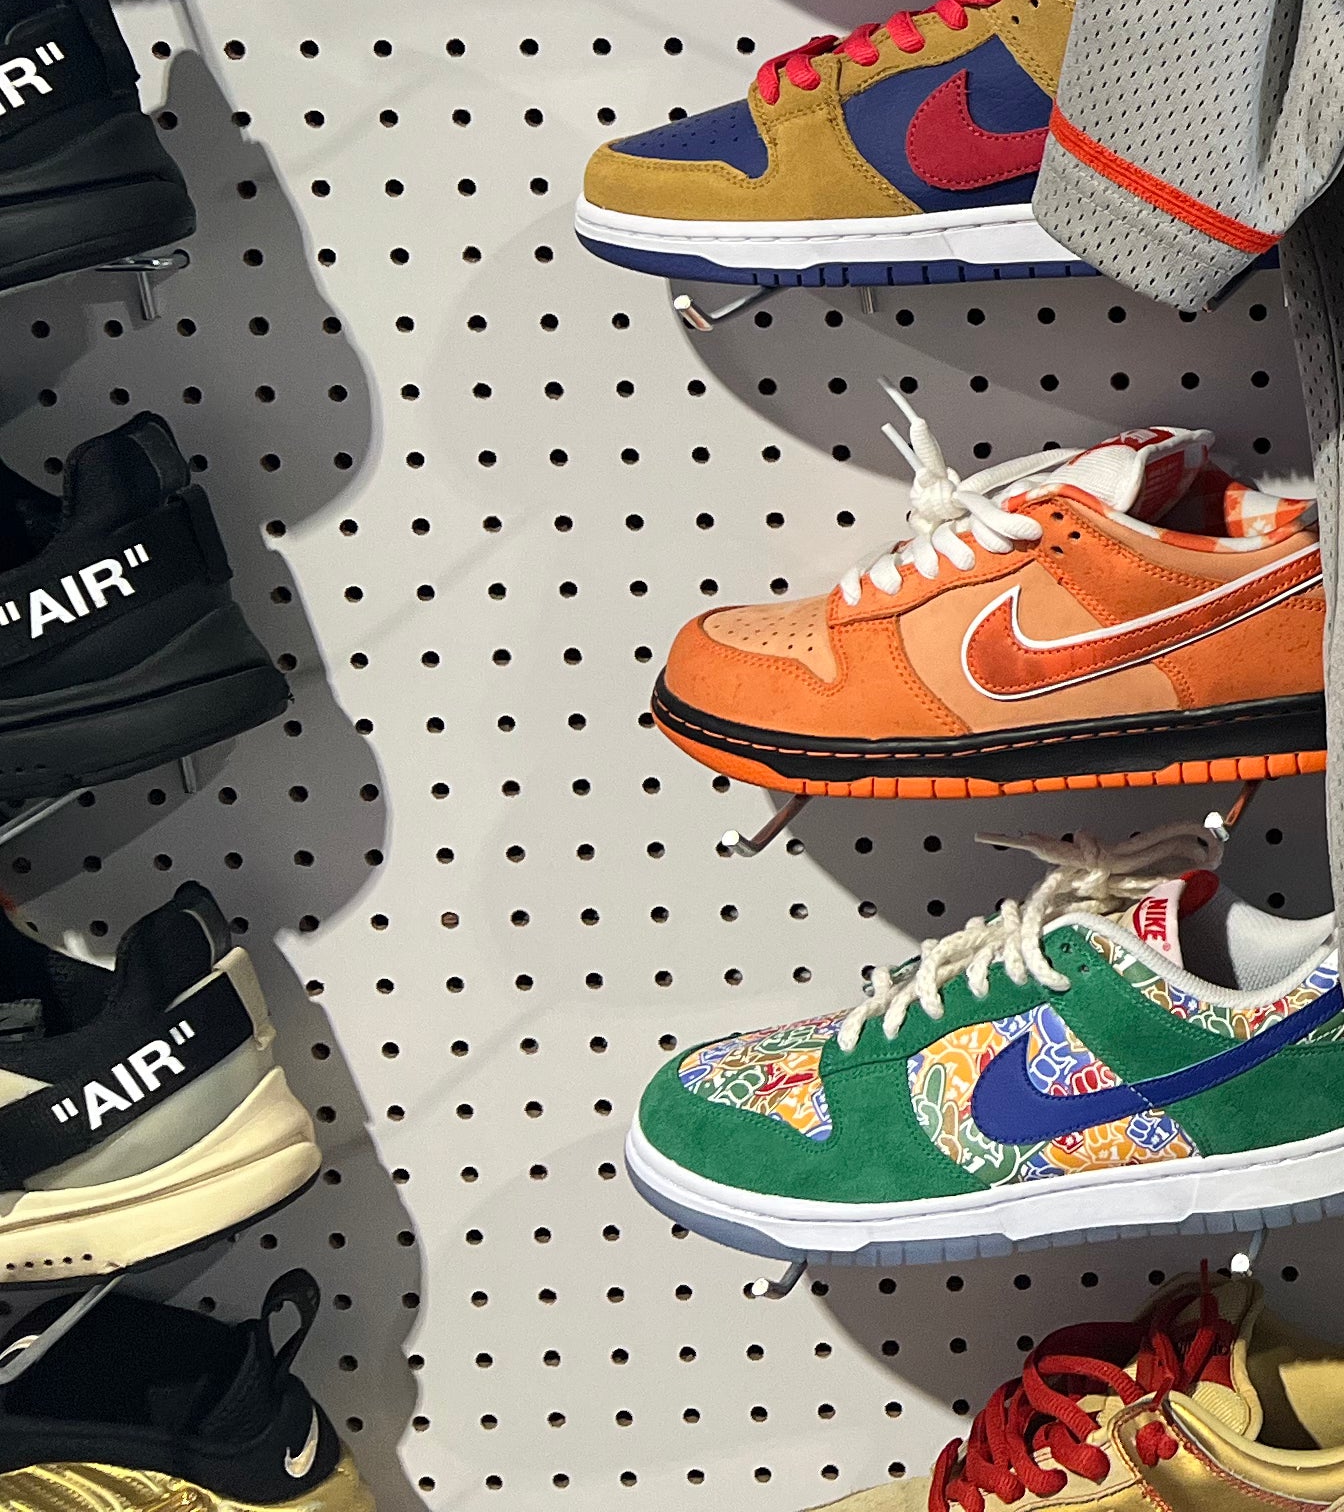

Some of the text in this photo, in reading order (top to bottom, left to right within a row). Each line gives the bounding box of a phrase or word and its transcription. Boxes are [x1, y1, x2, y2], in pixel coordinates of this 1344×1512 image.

[1144, 898, 1169, 942] NIKE
[50, 1020, 196, 1131] "AIR"
[1098, 1146, 1120, 1161] #1
